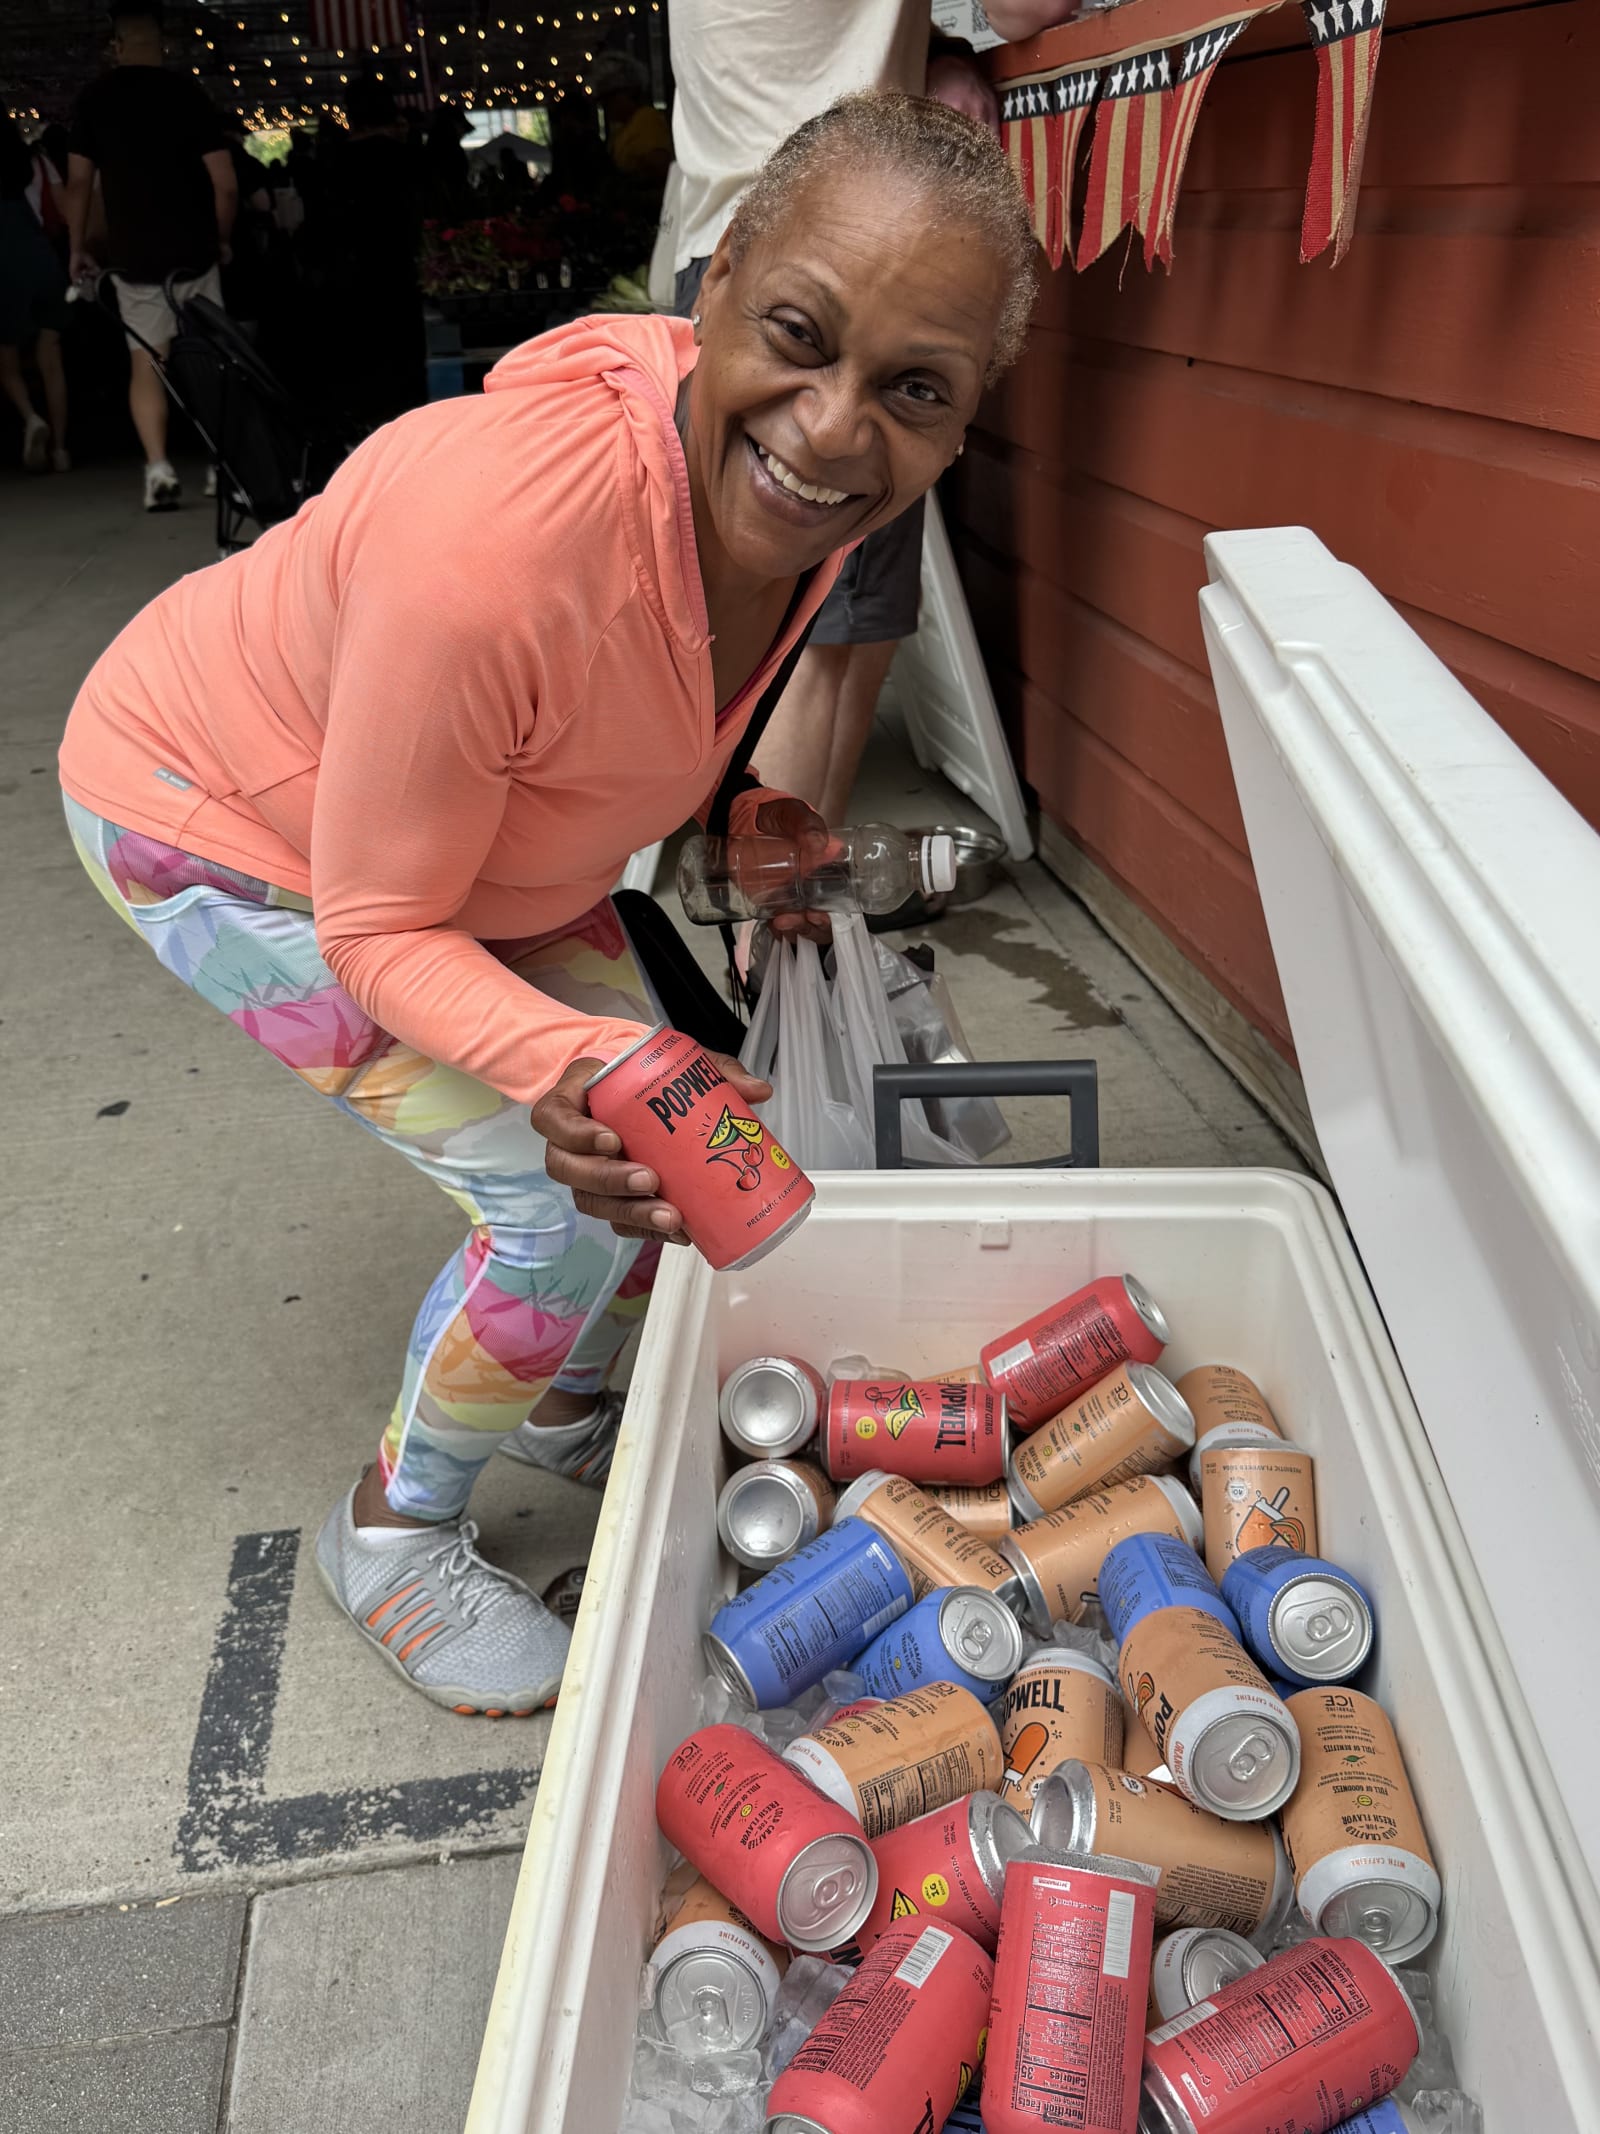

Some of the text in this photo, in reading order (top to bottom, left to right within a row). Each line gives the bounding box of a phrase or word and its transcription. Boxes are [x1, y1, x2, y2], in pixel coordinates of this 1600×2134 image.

[1112, 1381, 1132, 1405] ICE
[986, 1560, 1009, 1578] ICE
[777, 1616, 790, 1631] 35
[1003, 1679, 1064, 1725] OPWELL
[1235, 1692, 1282, 1715] WITH CAFFEINE
[1320, 1695, 1353, 1707] ICE
[905, 1707, 919, 1718] FULL
[870, 1722, 883, 1734] FULL
[837, 1729, 855, 1746] FRESH
[671, 1741, 699, 1770] ICE
[1323, 1744, 1351, 1752] BENEFITS
[1361, 1745, 1375, 1754] FULL
[810, 1750, 823, 1766] WITH
[1174, 1741, 1184, 1775] ORANGE
[695, 1761, 734, 1805] FULL OF BENEFITS
[876, 1780, 890, 1796] 35
[1331, 1782, 1364, 1795] GOODNESS
[1372, 1785, 1388, 1795] FULL
[720, 1782, 761, 1829] FULL OF GOODNESS
[862, 1788, 873, 1813] Facts
[739, 1800, 779, 1845] FRESH FLAVOR
[746, 1806, 783, 1849] COLD CRAFTED
[756, 1818, 768, 1832] FOR
[1340, 1812, 1397, 1827] FRESH FLAVOR
[1344, 1825, 1397, 1840] COLD CRAFTED
[1350, 1854, 1405, 1868] WITH CAFFEINE
[926, 1881, 941, 1898] 1G
[949, 1854, 984, 1920] FLAVORED SODA
[718, 1930, 764, 1966] WITH CAFFEINE
[1164, 1940, 1178, 1968] CAFFEINE
[1319, 1952, 1365, 2009] Nutrition Facts
[1298, 1965, 1346, 2022] Calories 35
[813, 2035, 841, 2047] Calories
[795, 2056, 827, 2067] Nutrition
[1380, 2064, 1398, 2074] COLD
[1020, 2065, 1086, 2087] Calories 35
[1368, 2068, 1378, 2089] FRESH
[1332, 2088, 1345, 2104] FULL
[1017, 2096, 1083, 2120] Nutrition Facts
